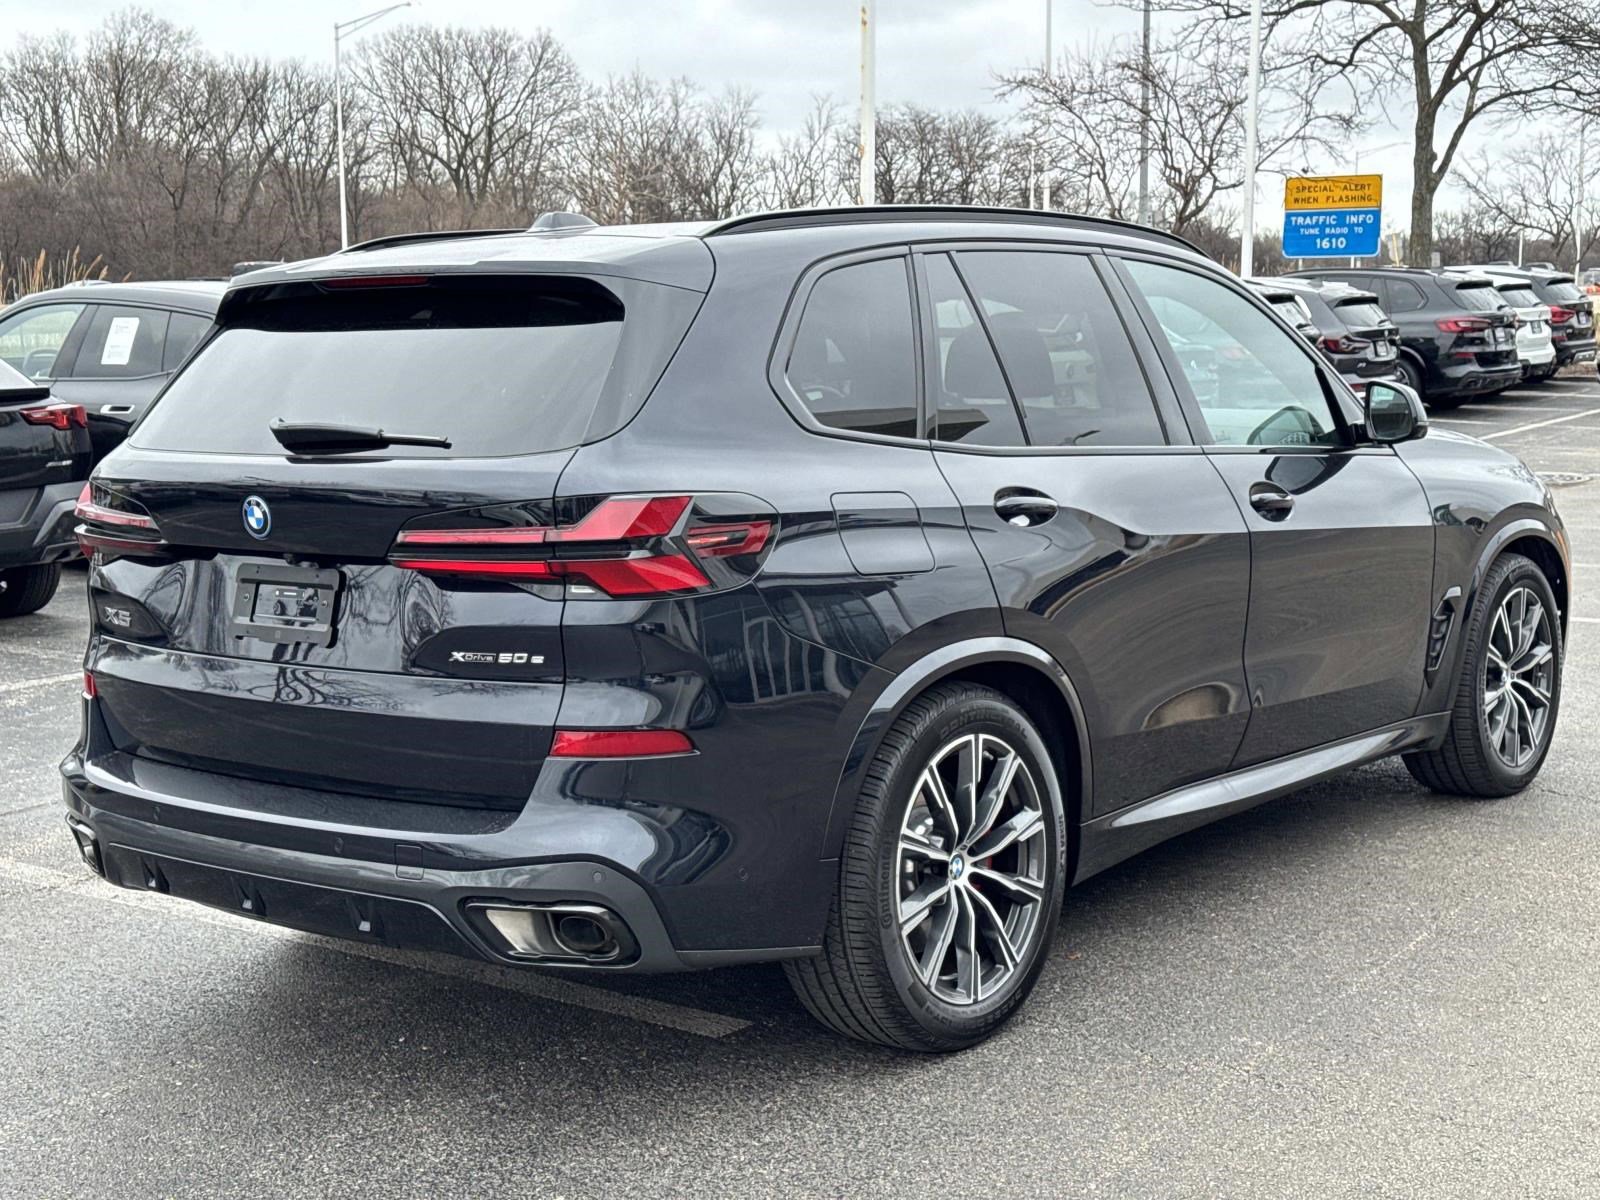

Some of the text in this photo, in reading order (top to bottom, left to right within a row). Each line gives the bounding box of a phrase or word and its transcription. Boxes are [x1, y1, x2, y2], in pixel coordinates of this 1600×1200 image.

[1295, 182, 1372, 194] SPECIAL ALERT
[1293, 194, 1373, 205] WHEN FLASHING
[1290, 213, 1374, 226] TRAFFIC INFO
[1299, 226, 1364, 236] TUNE RADIO TO
[1315, 236, 1347, 250] 1610
[104, 606, 132, 628] X5
